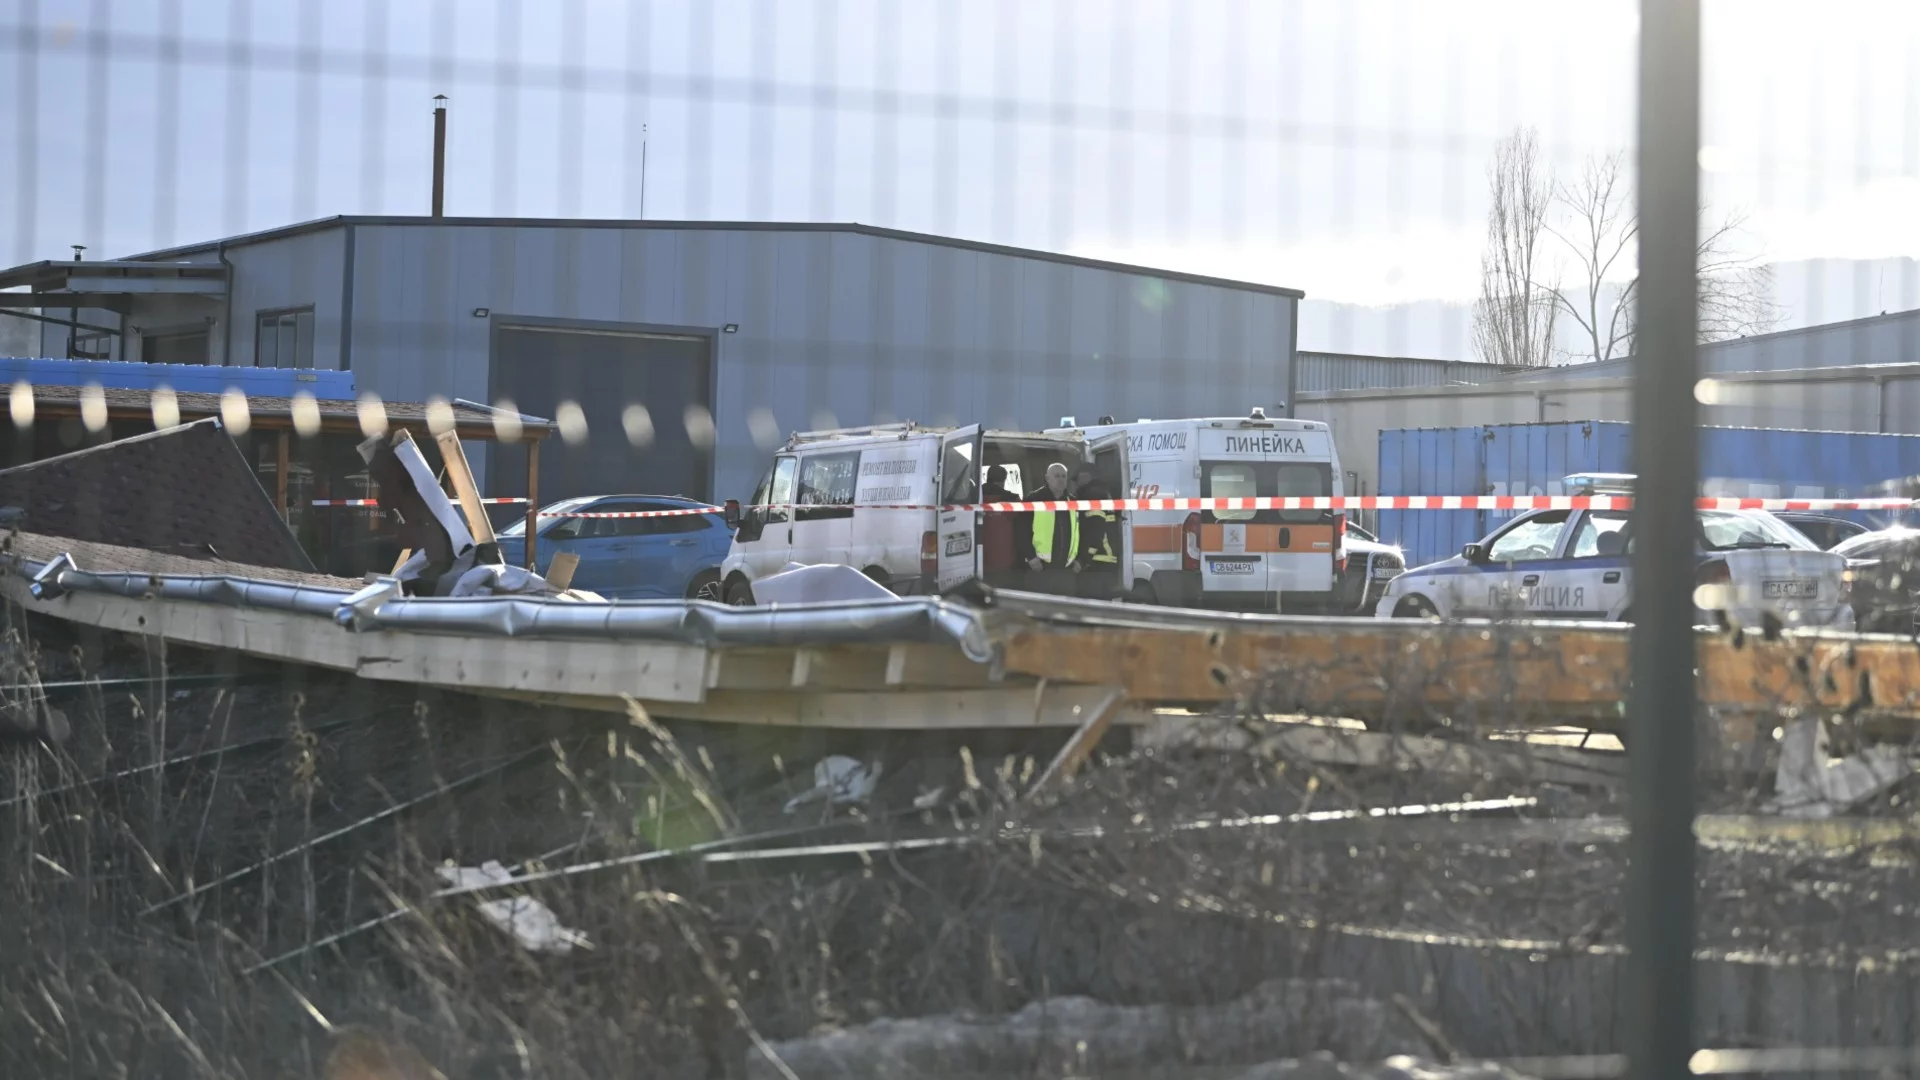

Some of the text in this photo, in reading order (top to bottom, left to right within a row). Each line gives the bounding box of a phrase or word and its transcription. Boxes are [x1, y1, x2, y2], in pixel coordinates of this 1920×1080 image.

[1148, 432, 1187, 451] ПОМОЩ
[1225, 433, 1305, 453] ЛИНЕЙКА
[1136, 484, 1160, 499] 112
[1488, 586, 1584, 609] ПИЦИЯ
